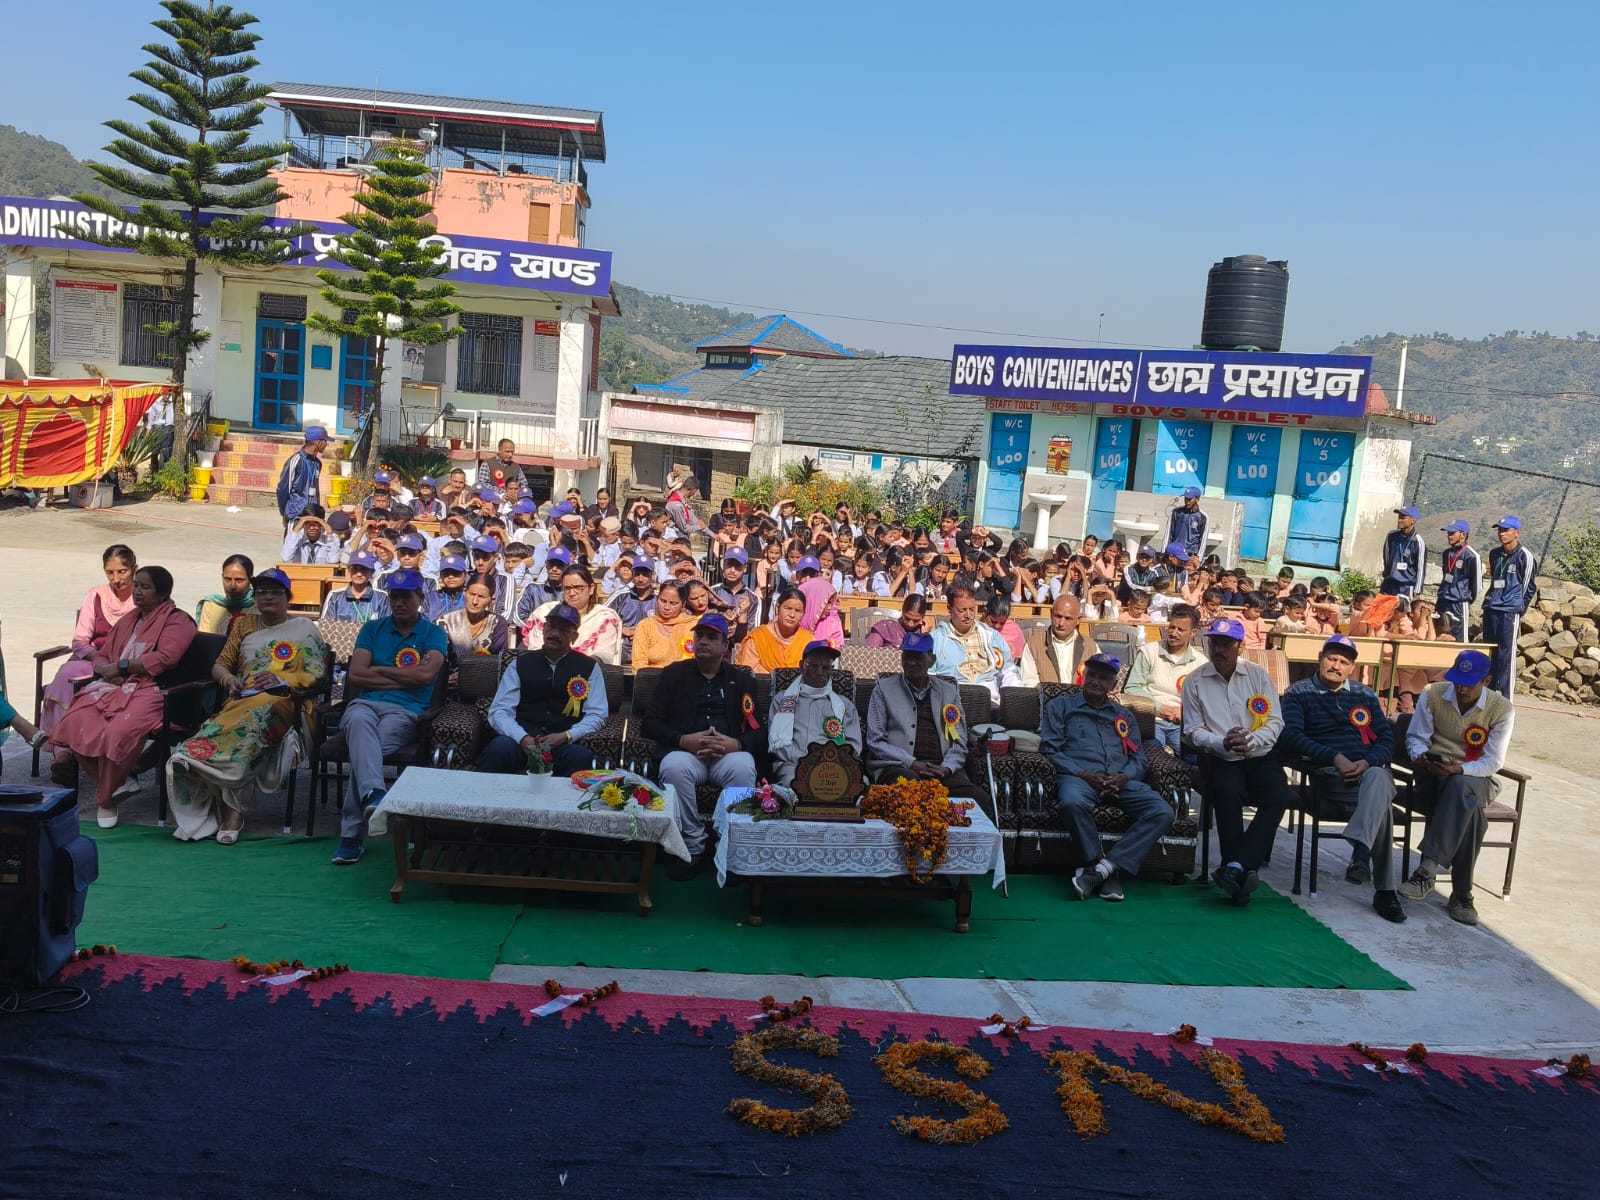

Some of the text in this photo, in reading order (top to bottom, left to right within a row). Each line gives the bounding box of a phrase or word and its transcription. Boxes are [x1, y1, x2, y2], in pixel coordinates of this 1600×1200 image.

[510, 250, 601, 287] खण्ड
[954, 355, 1134, 394] BOYS CONVENIENCES
[1148, 361, 1365, 403] छात्र प्रसाधन
[989, 400, 1011, 409] STAFF
[1014, 401, 1041, 410] TOILET
[1200, 409, 1313, 425] TOILET
[1004, 419, 1023, 429] W/C
[1110, 424, 1122, 434] W/C
[1174, 428, 1194, 437] W/C
[1246, 432, 1266, 443] W/C
[1008, 435, 1014, 447] 1
[1111, 435, 1117, 446] 2
[1180, 439, 1188, 450] 3
[1313, 437, 1338, 448] W/C
[1249, 443, 1259, 455] 4
[1319, 449, 1329, 461] 5
[997, 452, 1022, 466] LOO
[1100, 453, 1121, 469] LOO
[1165, 458, 1198, 474] LOO
[1237, 464, 1268, 479] LOO
[1305, 470, 1341, 487] LOO
